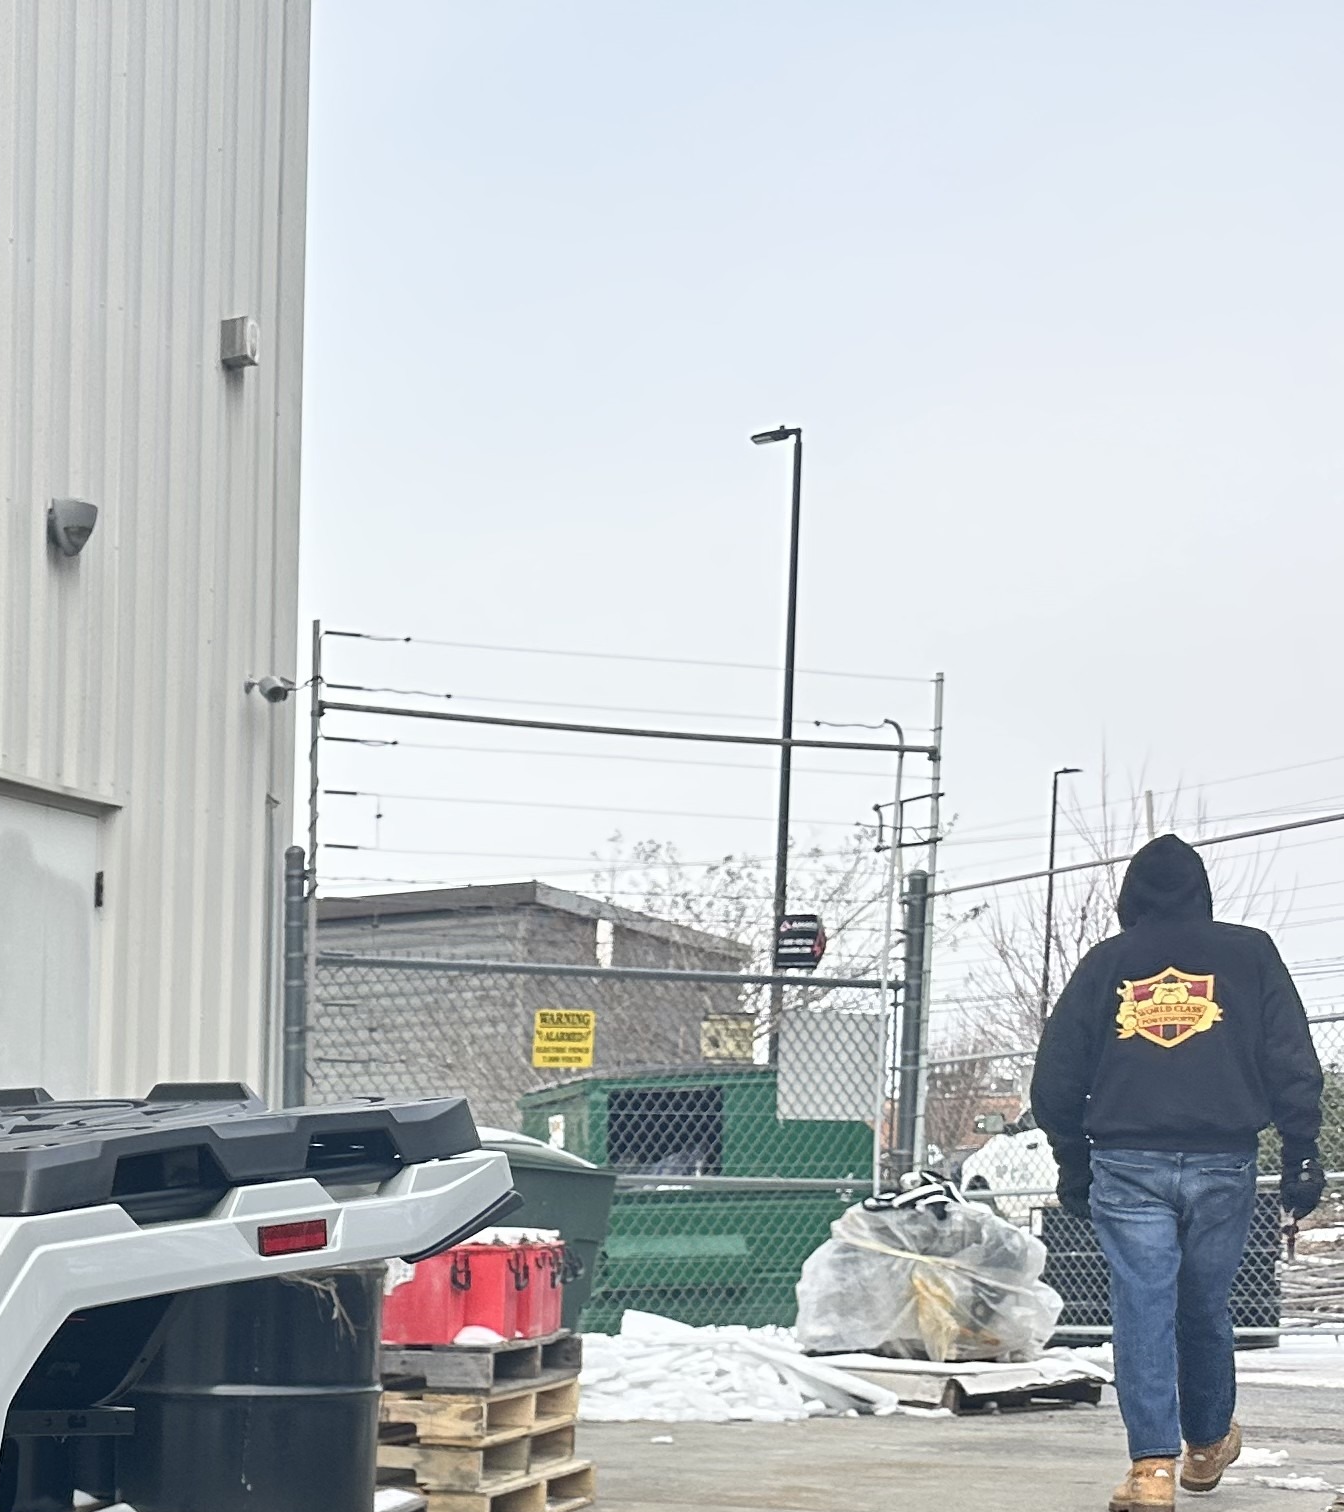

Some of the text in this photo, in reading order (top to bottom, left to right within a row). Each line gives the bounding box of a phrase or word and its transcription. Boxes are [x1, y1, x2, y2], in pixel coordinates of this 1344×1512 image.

[1138, 1004, 1203, 1017] WORLD CLASS
[540, 1012, 591, 1025] WARNING
